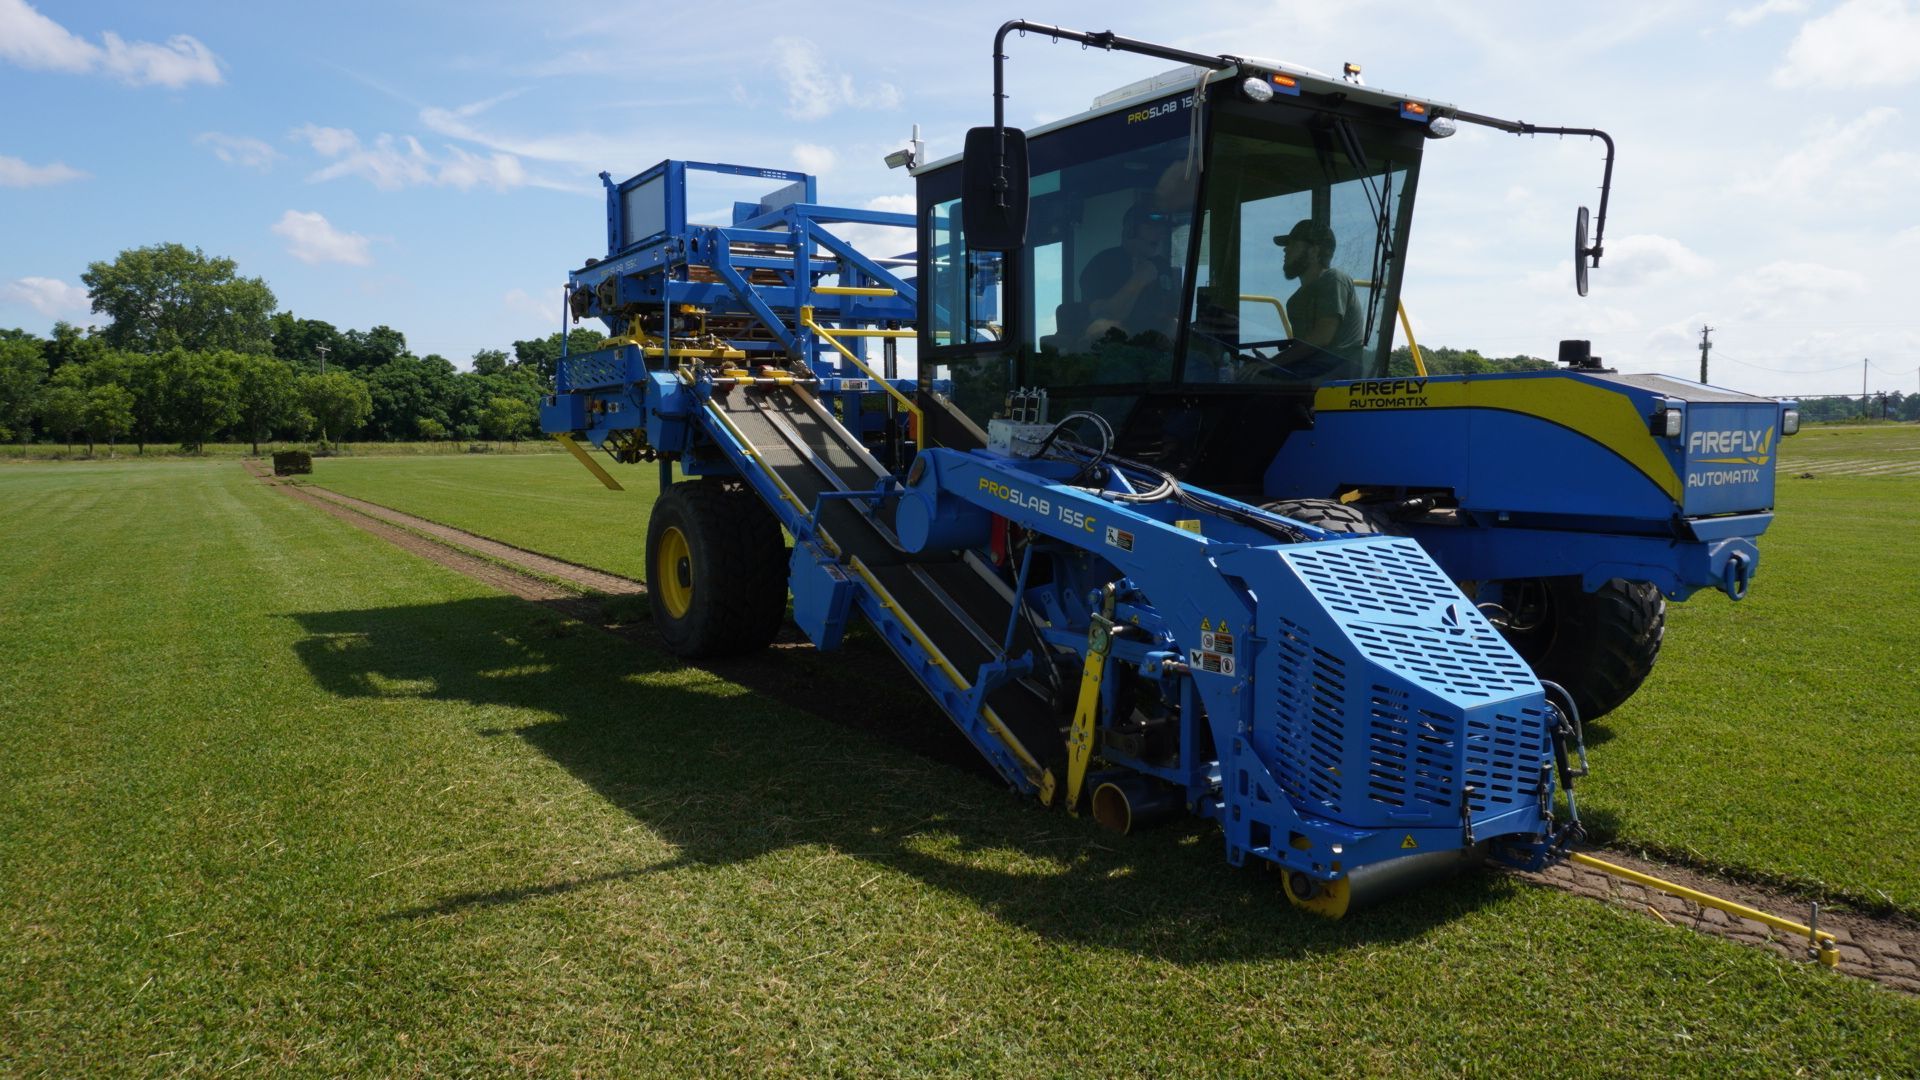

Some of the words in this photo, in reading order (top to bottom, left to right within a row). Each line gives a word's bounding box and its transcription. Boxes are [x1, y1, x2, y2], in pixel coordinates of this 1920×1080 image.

[1127, 101, 1177, 125] PROSLAB
[1349, 380, 1427, 396] FIREFLY
[1349, 397, 1428, 408] AUTOMATIX
[1688, 430, 1761, 454] FIREFLY
[1687, 469, 1759, 488] AUTOMATIX
[979, 478, 1050, 516] PROSLAB
[1057, 505, 1097, 533] 155C
